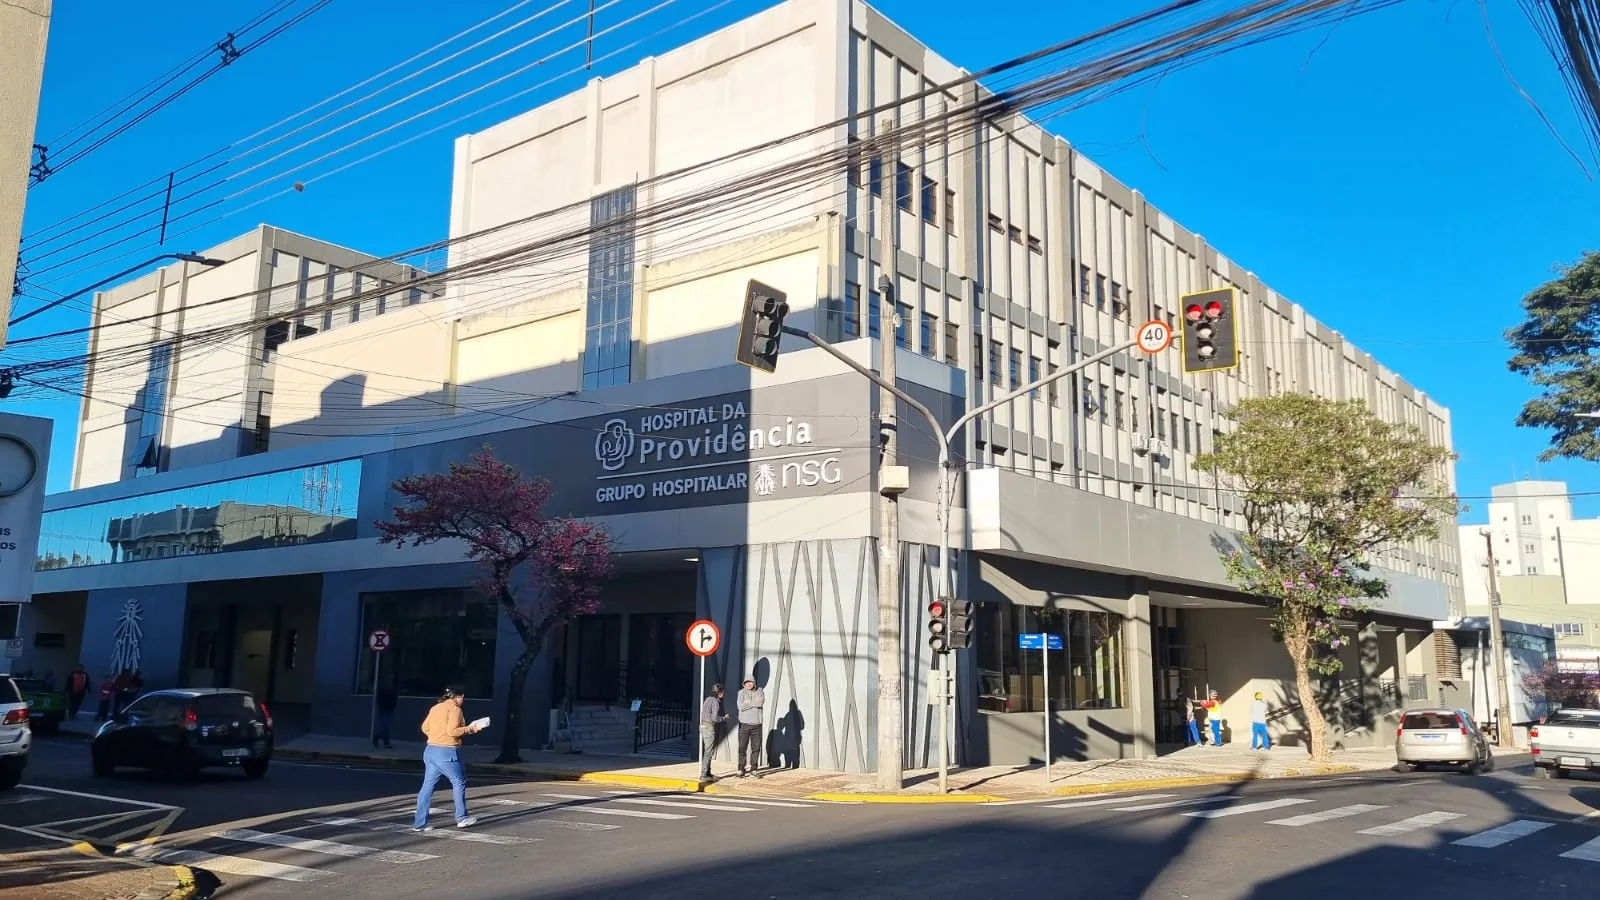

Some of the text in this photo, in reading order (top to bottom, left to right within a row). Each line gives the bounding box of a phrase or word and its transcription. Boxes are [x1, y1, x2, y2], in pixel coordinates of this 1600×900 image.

[1144, 327, 1163, 341] 40
[641, 401, 746, 433] HOSPITAL DA
[639, 416, 812, 465] Providência
[596, 472, 748, 503] GRUPO HOSPITALAR
